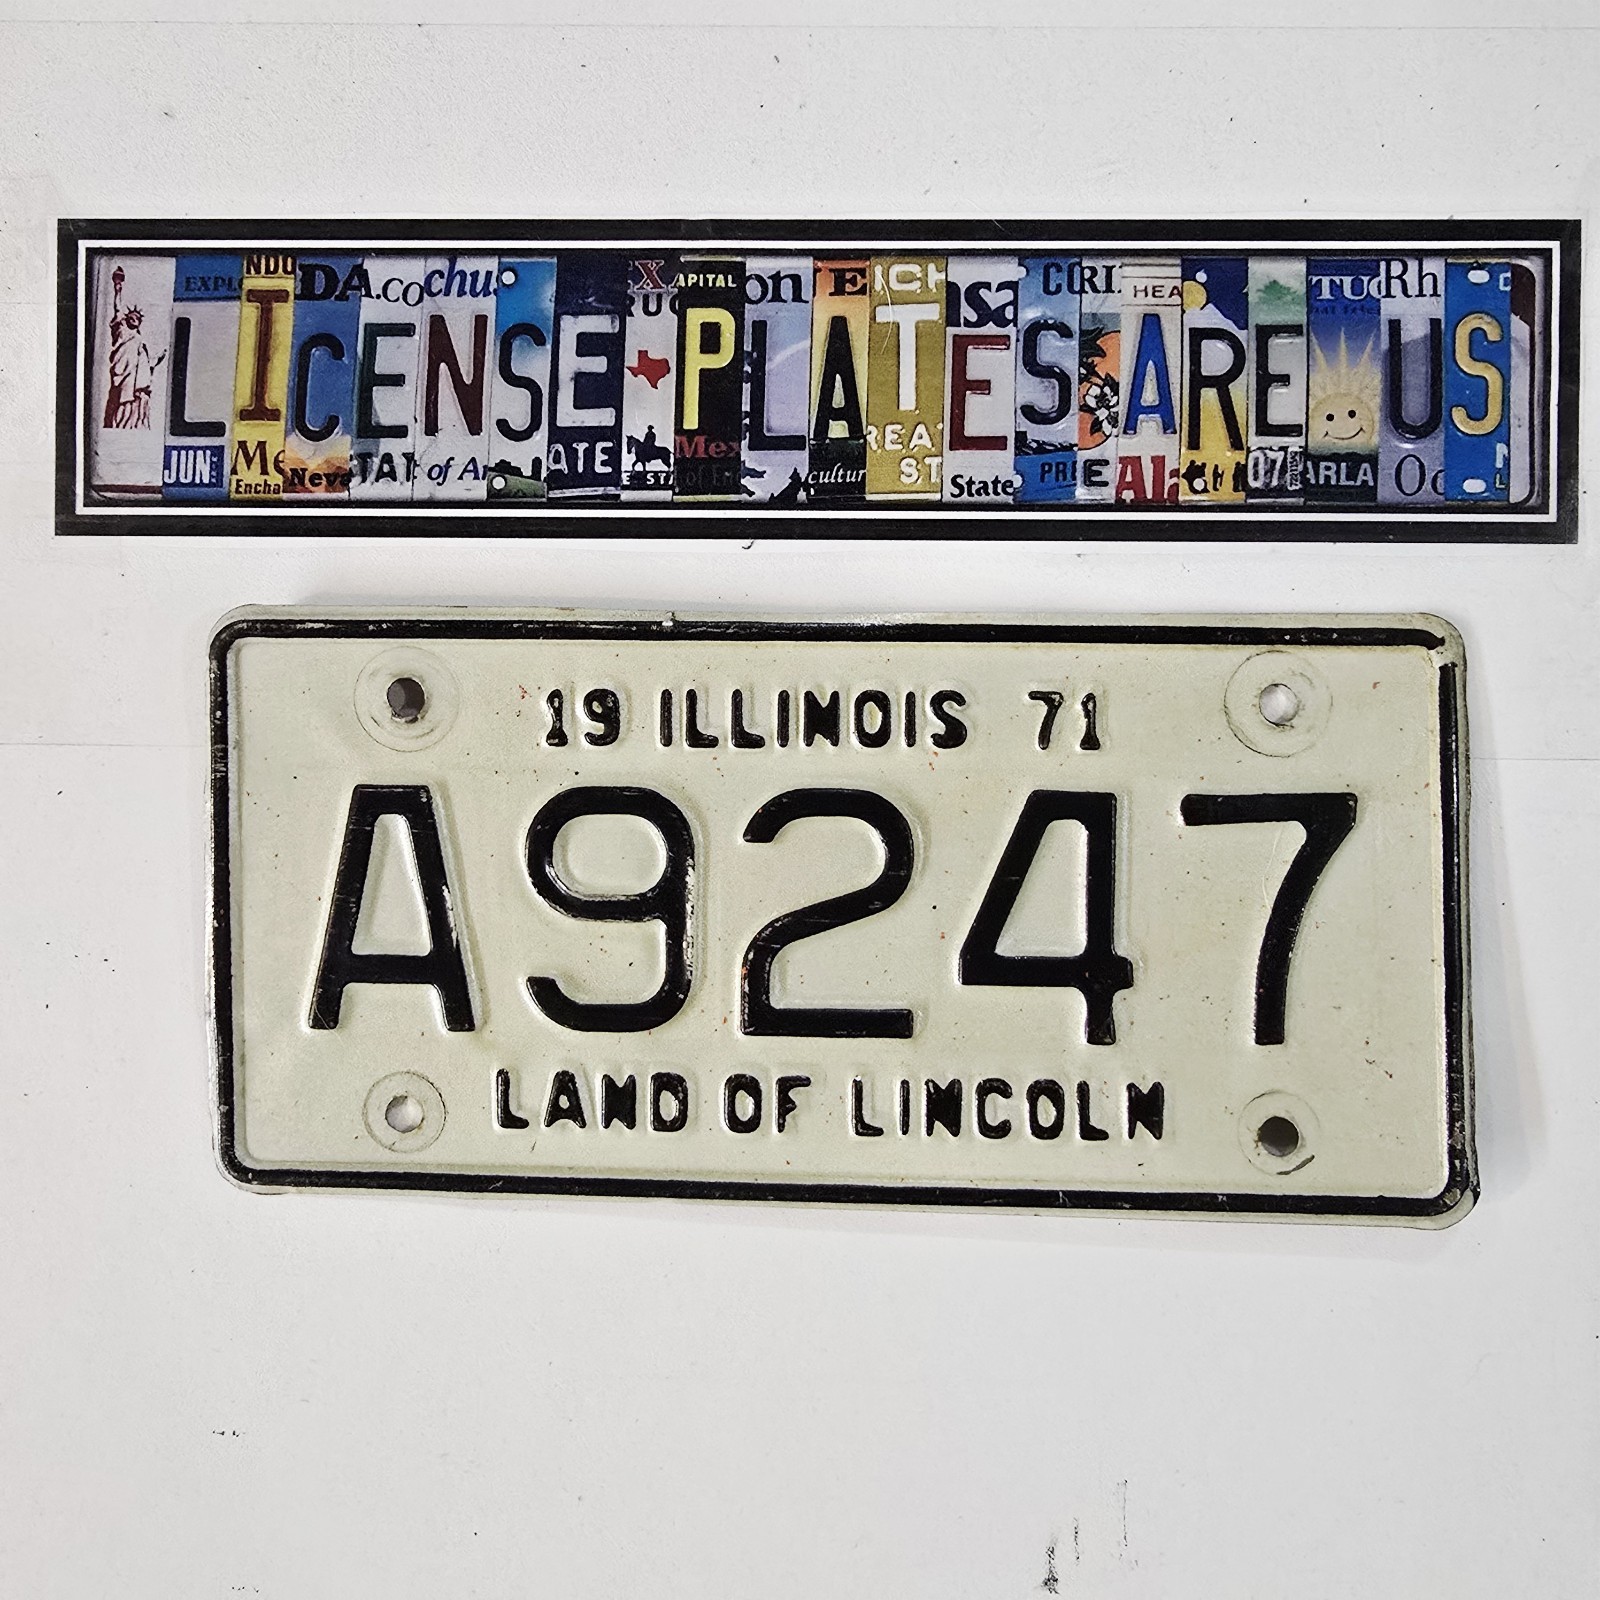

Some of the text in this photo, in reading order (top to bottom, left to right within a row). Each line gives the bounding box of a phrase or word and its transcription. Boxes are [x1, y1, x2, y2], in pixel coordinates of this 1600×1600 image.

[169, 287, 1505, 452] LICENSE PLATES ARE US
[163, 449, 212, 484] JUN
[427, 456, 455, 487] of
[950, 474, 1014, 499] State
[545, 688, 1102, 751] 19 ILLINOIS 71
[307, 783, 1359, 1046] A9247
[496, 1068, 1166, 1142] LAND OF LINCOLN
